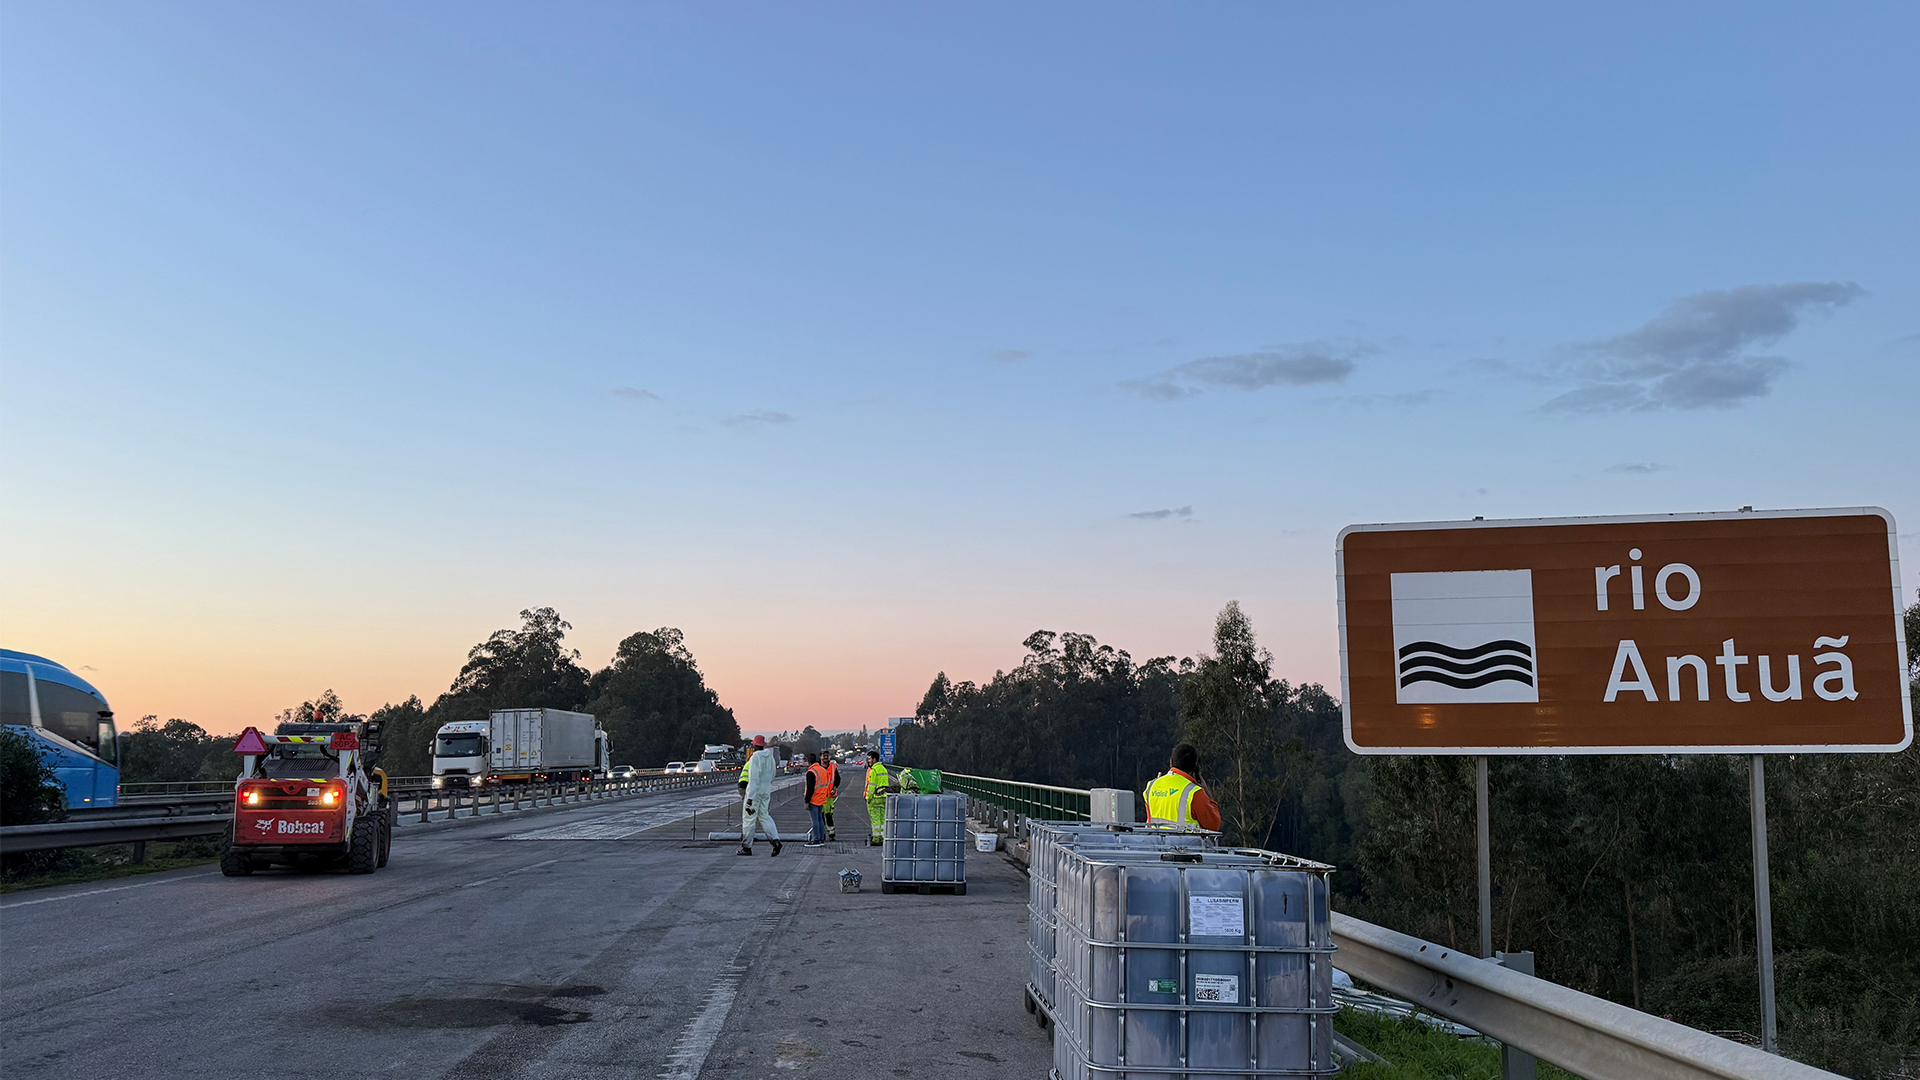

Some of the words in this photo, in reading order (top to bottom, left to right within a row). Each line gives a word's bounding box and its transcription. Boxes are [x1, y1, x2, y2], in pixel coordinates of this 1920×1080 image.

[1595, 548, 1701, 611] rio
[1603, 635, 1859, 703] Antuã
[339, 733, 351, 741] AC
[277, 819, 325, 834] Bobcat
